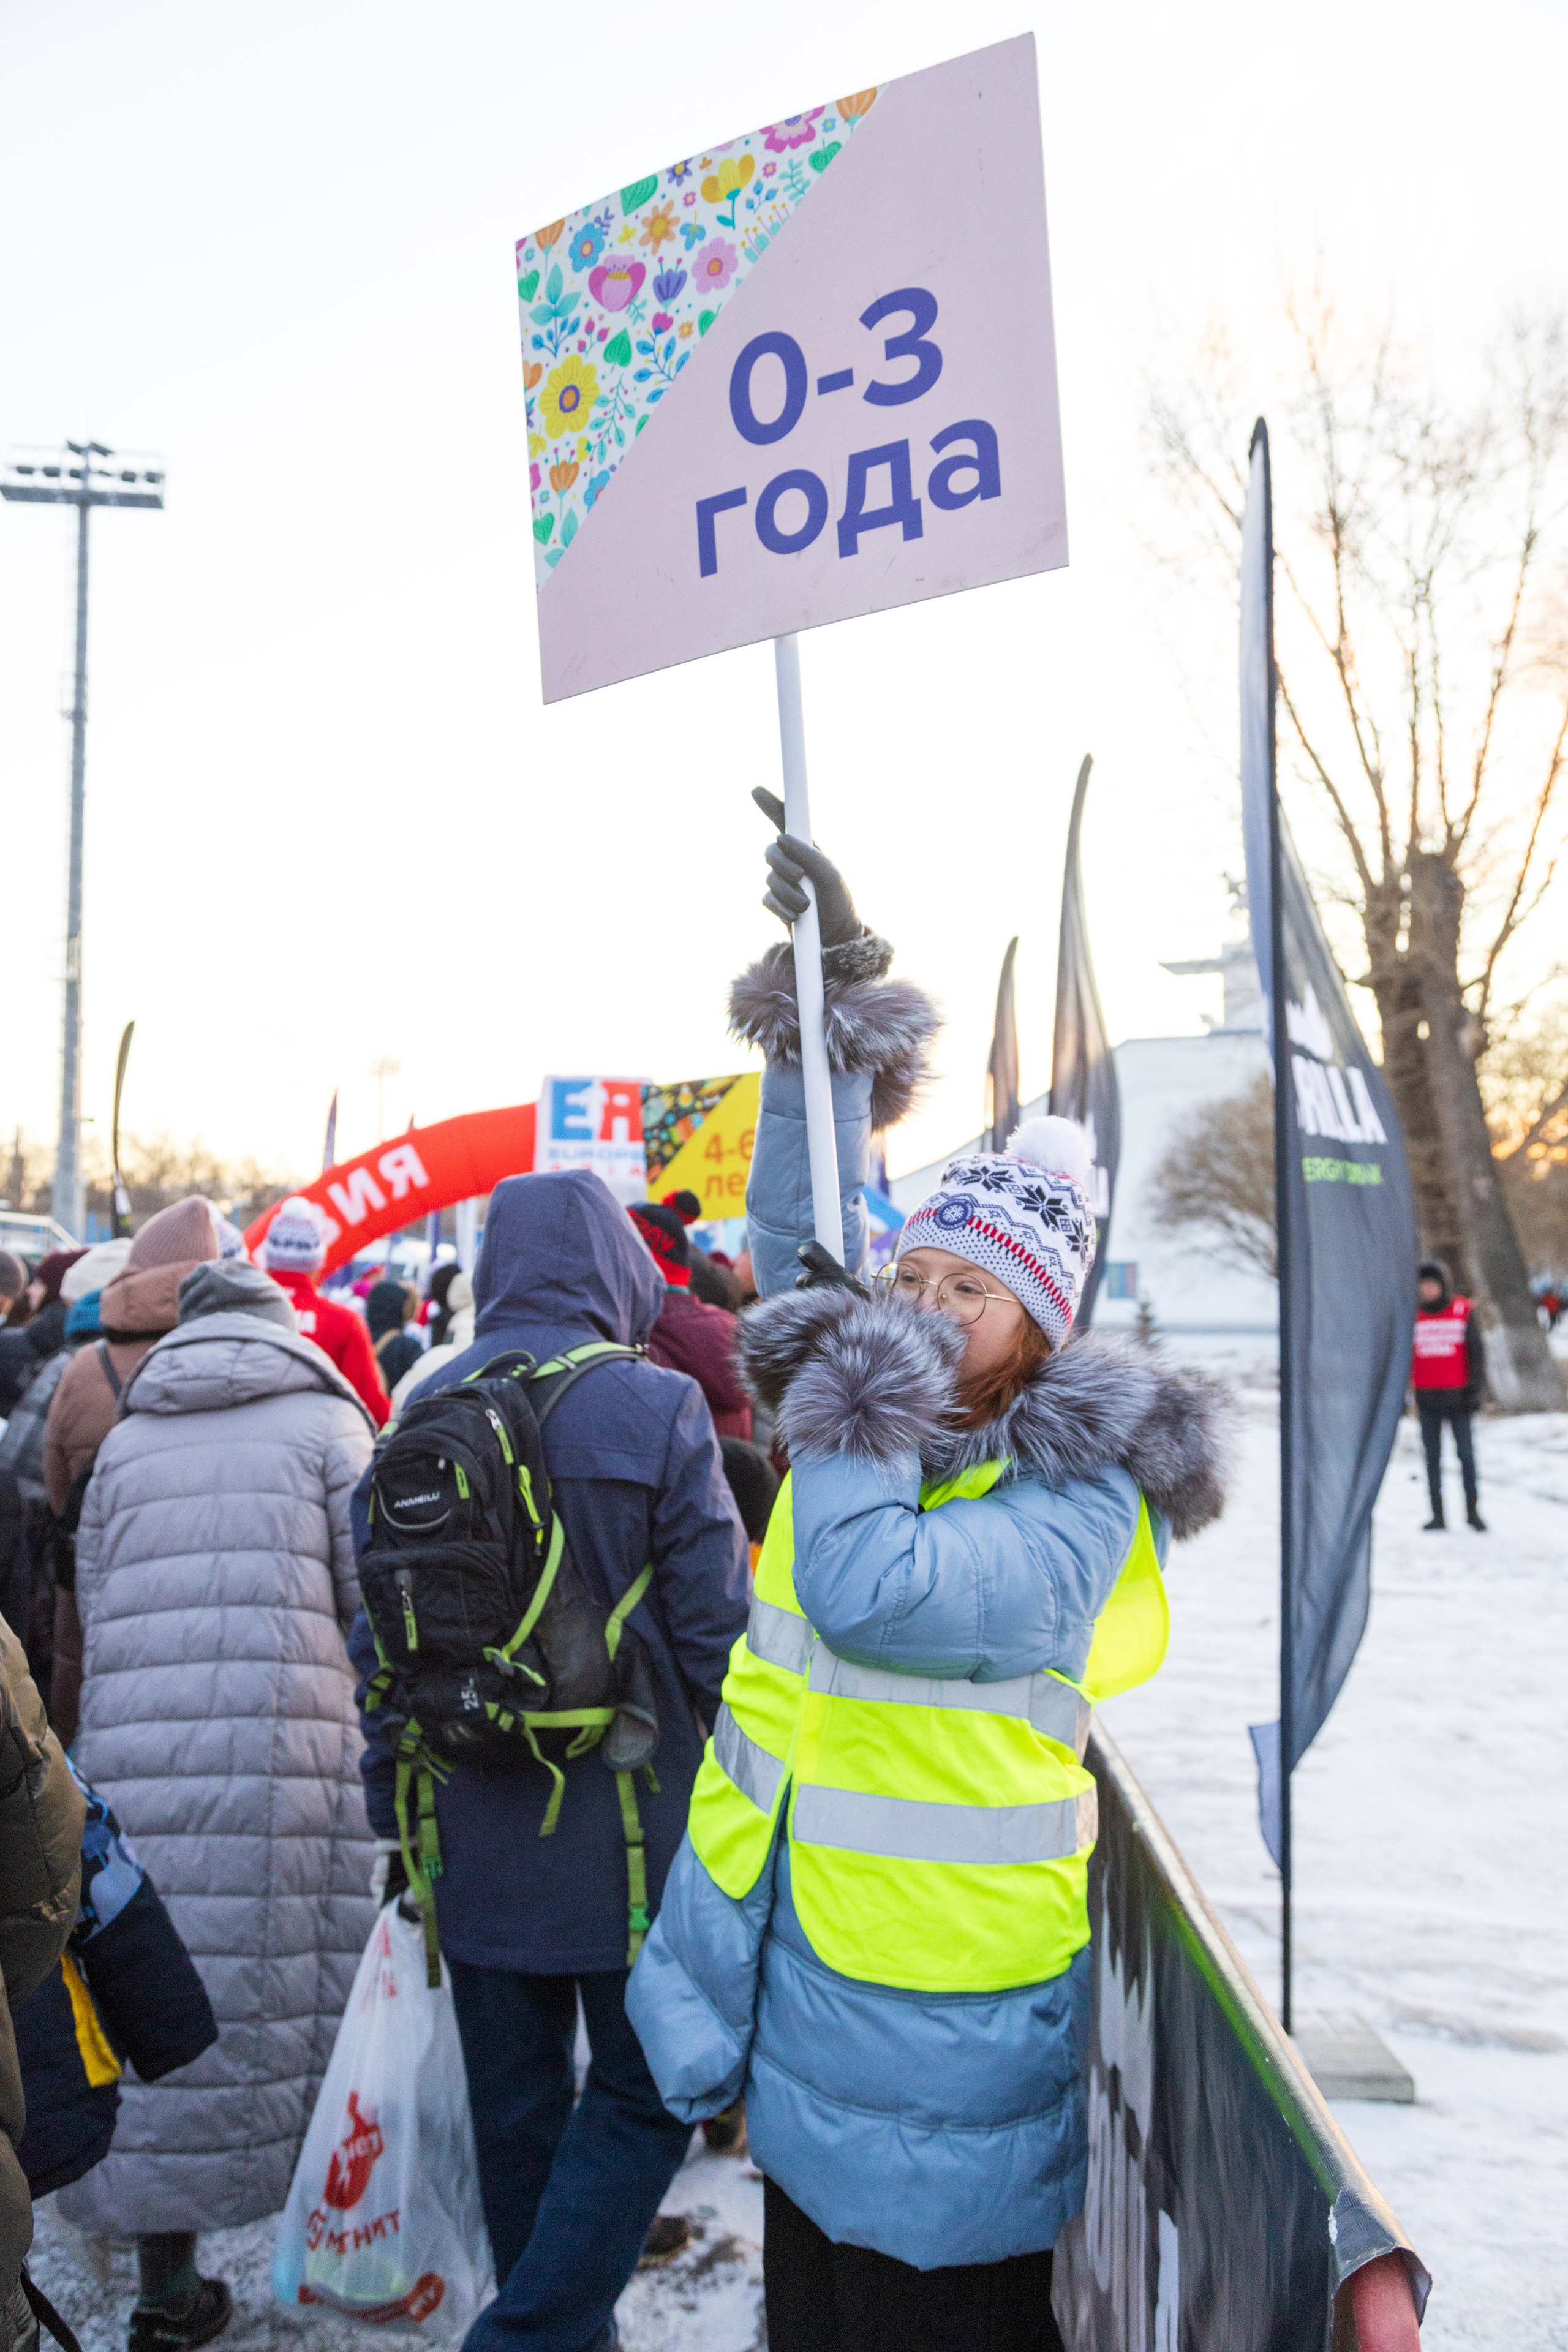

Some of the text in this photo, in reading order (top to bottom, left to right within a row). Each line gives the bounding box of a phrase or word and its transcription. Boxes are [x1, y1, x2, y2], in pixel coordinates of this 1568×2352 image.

[729, 287, 943, 446] 0-3
[696, 419, 1001, 578] года
[704, 1171, 747, 1199] ле
